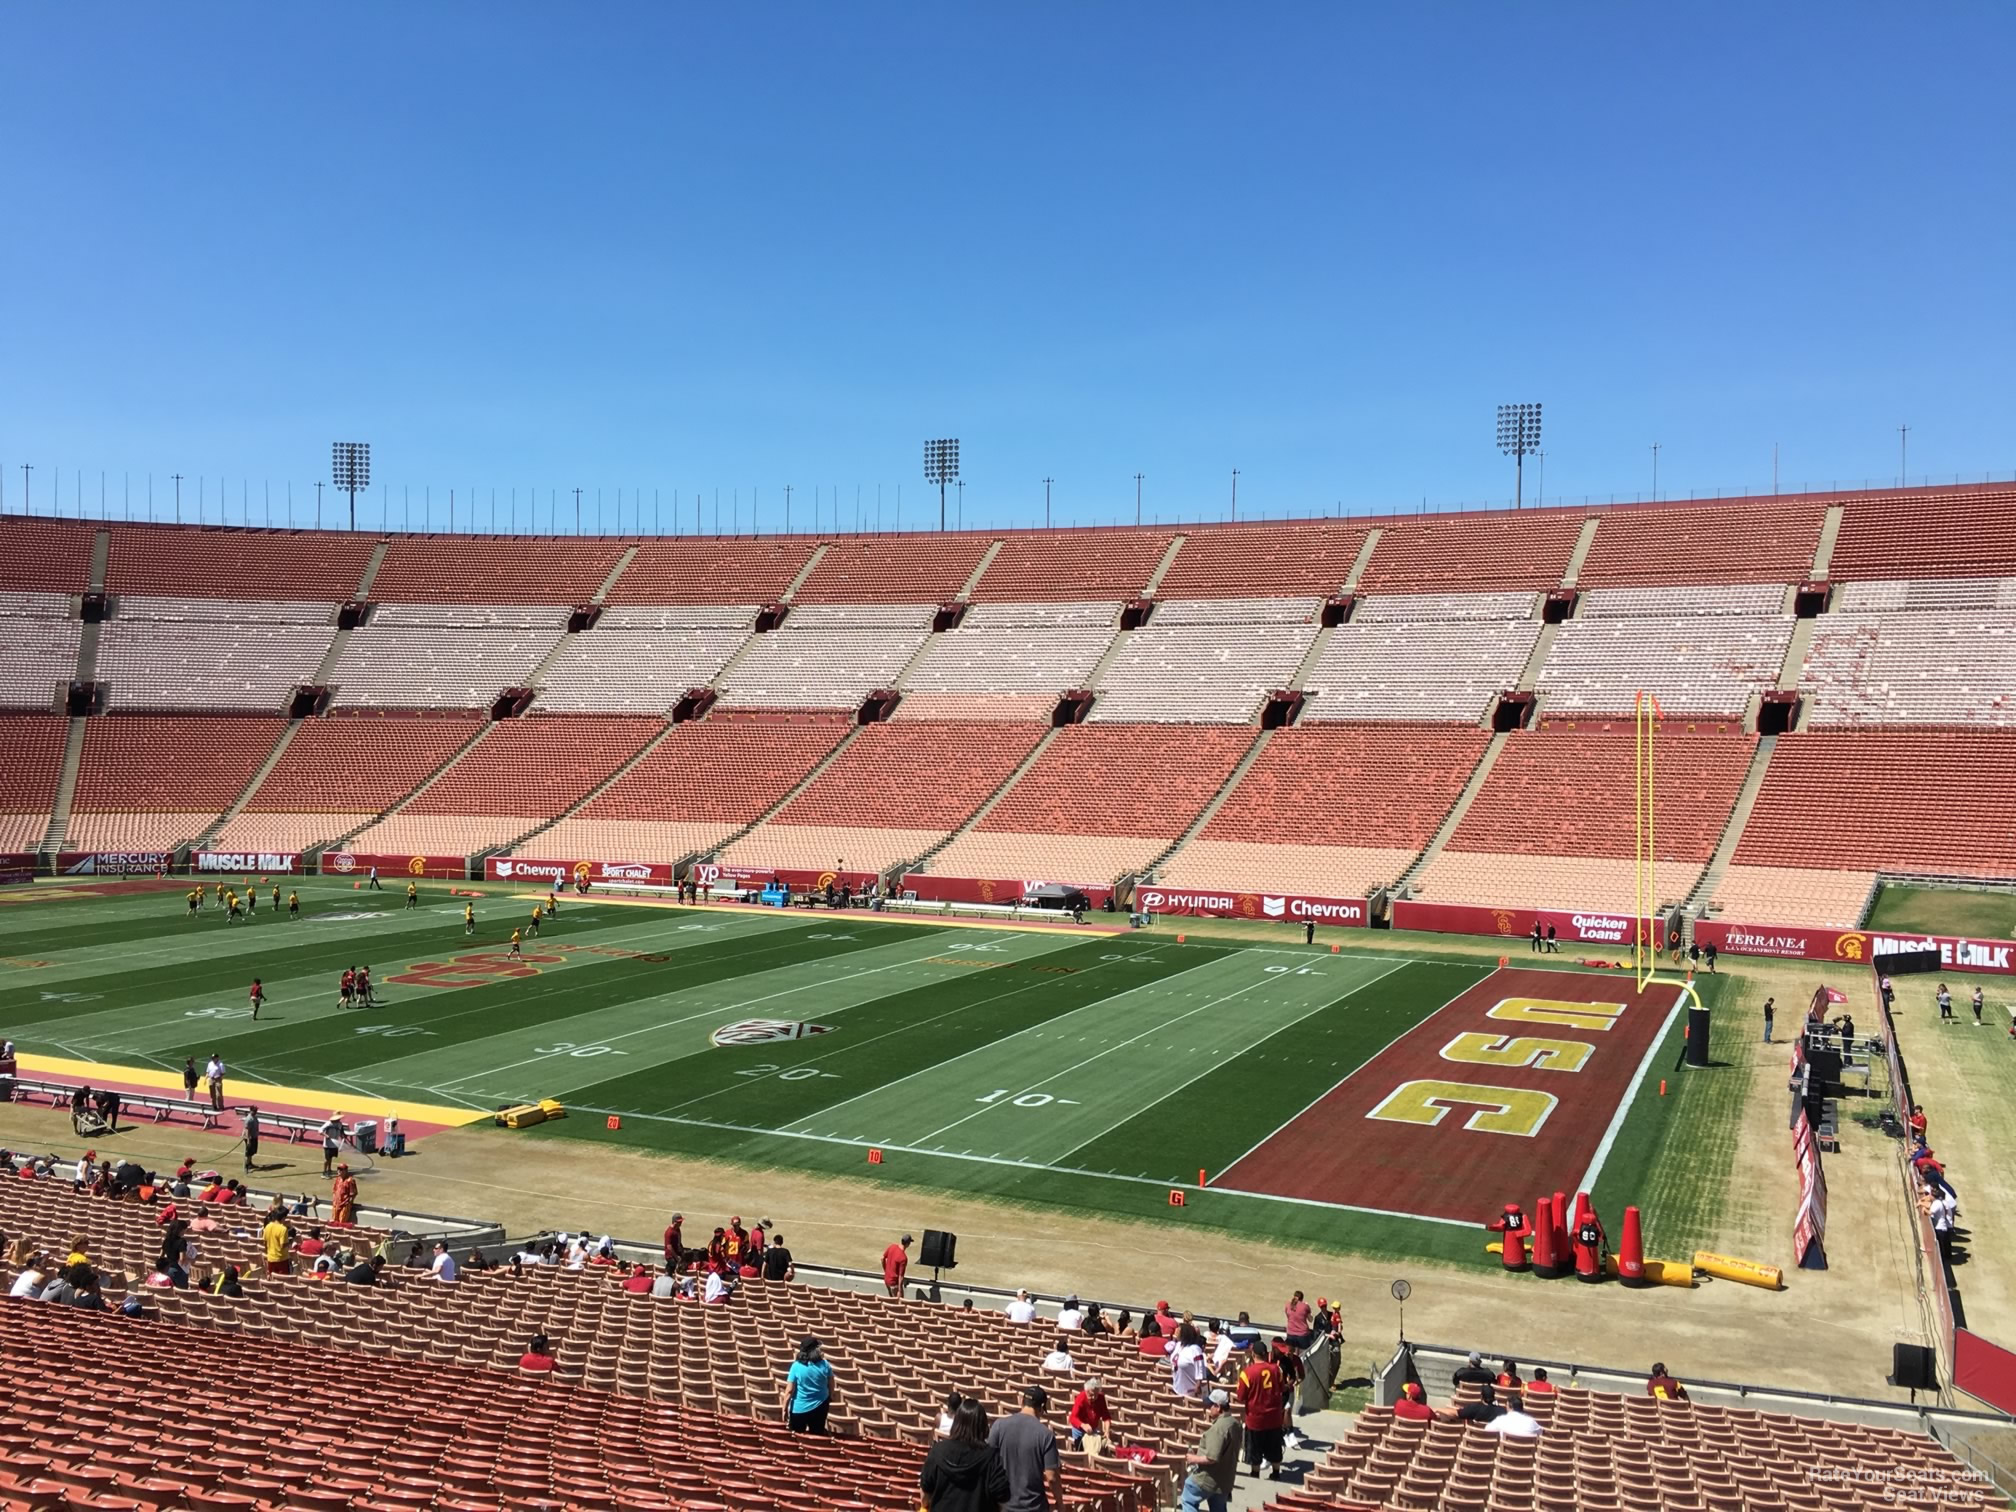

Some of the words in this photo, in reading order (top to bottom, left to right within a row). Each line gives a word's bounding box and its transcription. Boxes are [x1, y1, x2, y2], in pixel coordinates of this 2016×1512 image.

[97, 853, 168, 864] MERCURY
[199, 853, 256, 870] MUSCLE
[258, 854, 293, 871] MILK
[97, 864, 168, 874] INSURANCE
[516, 863, 566, 877] Chevron
[602, 867, 625, 877] SPORT
[625, 869, 651, 879] CHALET
[699, 866, 719, 881] yp
[1168, 894, 1233, 909] HYUNDAI
[1291, 900, 1361, 919] Chevron
[1572, 915, 1628, 930] Quicken
[1579, 927, 1622, 941] Loans
[1725, 933, 1806, 949] TERRANEA
[1956, 943, 2010, 968] MILK
[534, 1043, 612, 1057] 30
[733, 1064, 820, 1080] 20
[1365, 997, 1628, 1137] USC
[974, 1089, 1054, 1107] 10
[608, 1117, 618, 1128] 20
[870, 1151, 880, 1162] 10
[1171, 1192, 1182, 1205] G
[728, 1241, 739, 1255] 21
[1261, 1370, 1273, 1389] 2
